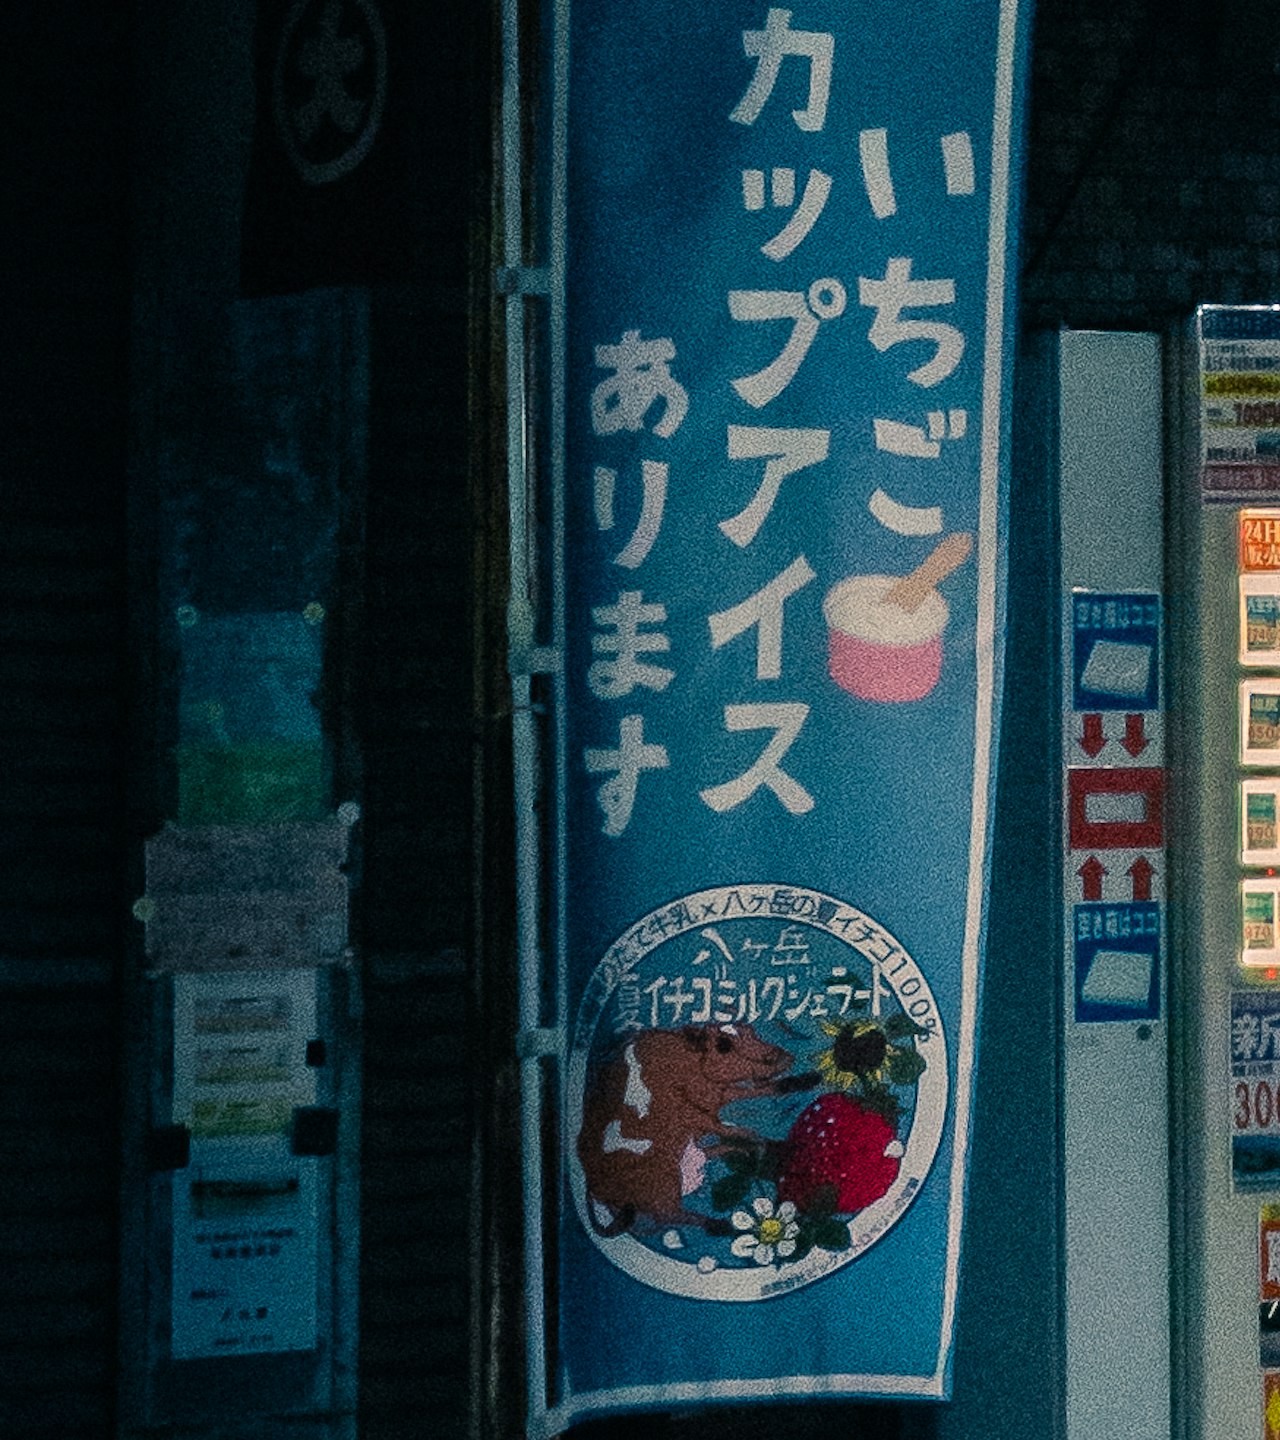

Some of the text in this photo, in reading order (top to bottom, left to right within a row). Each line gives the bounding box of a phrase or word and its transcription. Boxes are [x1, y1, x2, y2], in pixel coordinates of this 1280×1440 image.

[699, 6, 847, 816] カップアイス
[857, 125, 978, 536] いちご
[584, 328, 690, 838] あります
[690, 924, 813, 968] 八ヶ岳
